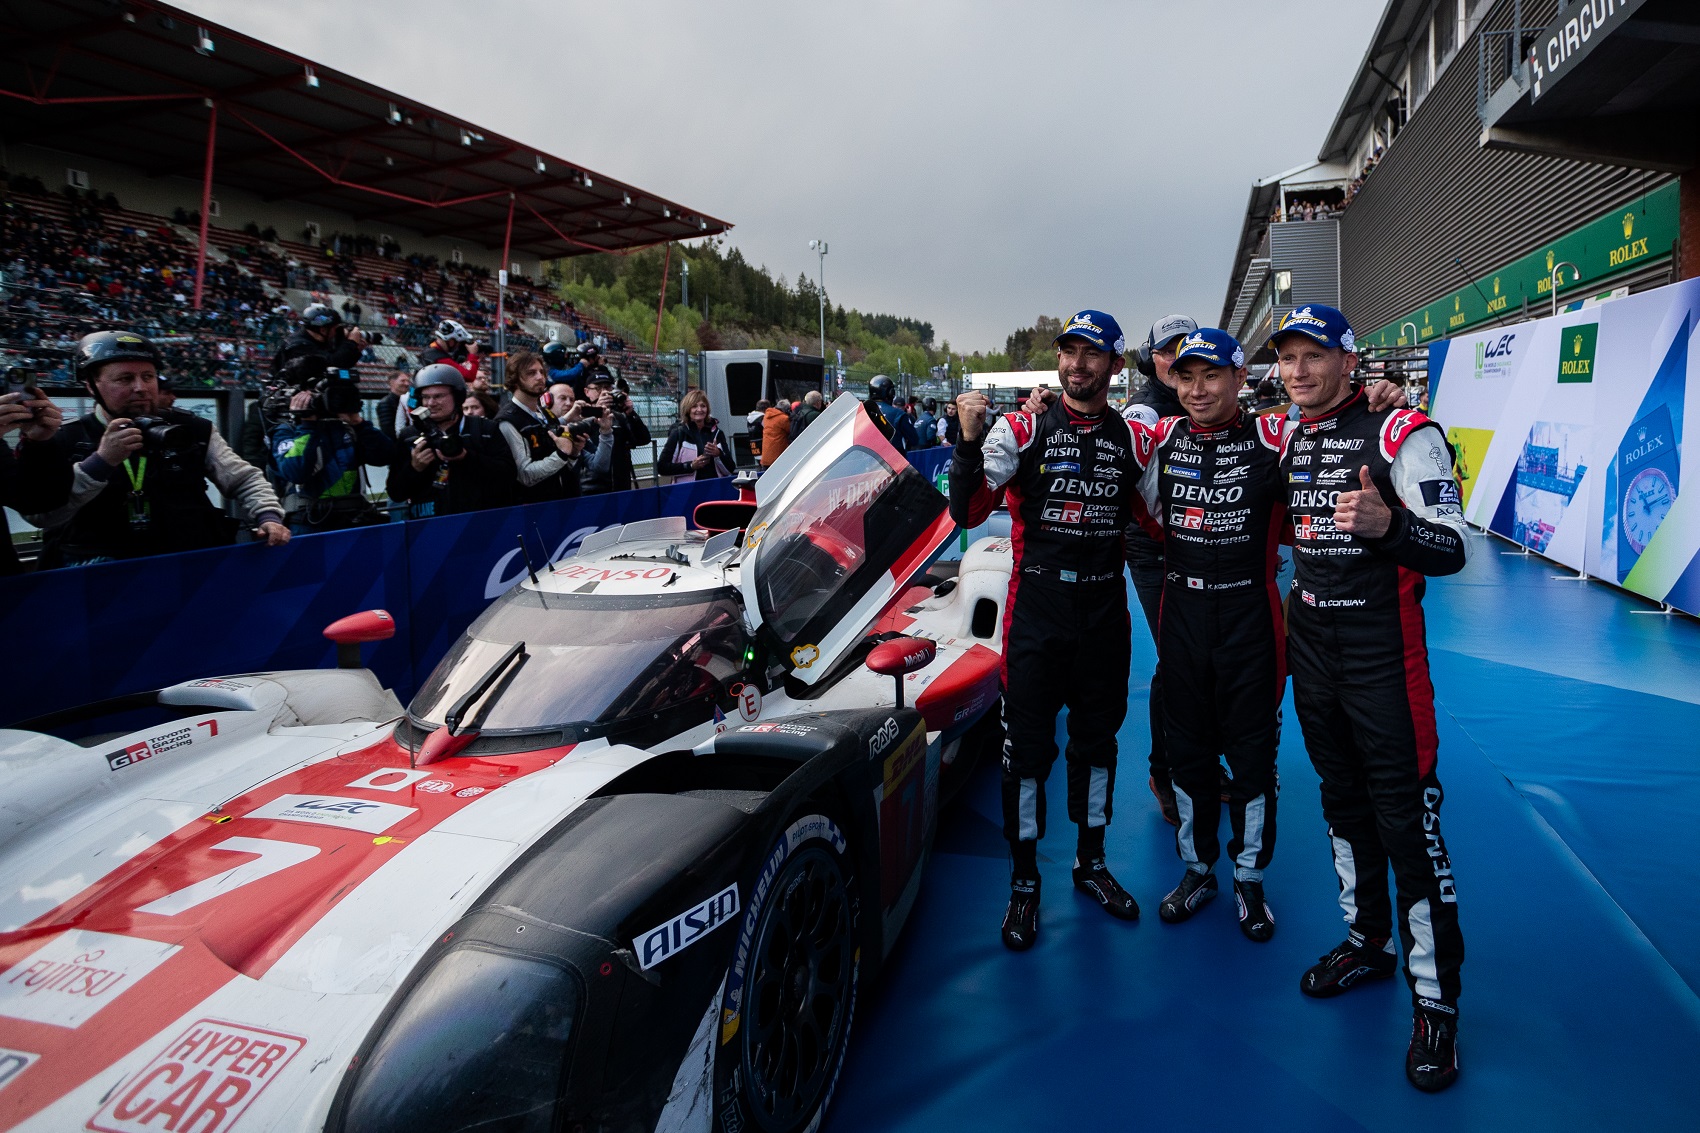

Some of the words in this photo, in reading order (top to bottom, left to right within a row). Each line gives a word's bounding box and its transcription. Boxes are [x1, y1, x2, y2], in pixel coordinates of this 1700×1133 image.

[1547, 0, 1626, 72] CIRCU
[1609, 238, 1648, 267] ROLEX
[1487, 296, 1507, 314] ROLEX
[1282, 318, 1327, 330] MICHELIN
[1450, 312, 1465, 327] ROLEX
[1475, 342, 1484, 369] 10
[1485, 334, 1515, 358] WEC
[1561, 360, 1590, 375] ROLEX
[1046, 430, 1079, 446] FUJITSU
[1175, 436, 1204, 452] FUJITSU
[1216, 443, 1243, 454] Mobil
[1322, 438, 1352, 450] Mobil
[1044, 447, 1080, 458] AISIN
[1096, 452, 1115, 462] ZENT
[1625, 435, 1664, 465] ROLEX
[1169, 452, 1202, 464] AISIN
[1216, 456, 1239, 466] ZENT
[1292, 455, 1312, 466] AISIN
[1321, 454, 1344, 464] ZENT
[1093, 465, 1122, 478] WEC
[1213, 465, 1251, 479] WEC
[1318, 468, 1352, 479] WEC
[1050, 478, 1119, 498] DENSO
[1171, 483, 1243, 504] DENSO
[1291, 489, 1341, 508] DENSO
[1043, 507, 1080, 522] GR
[1082, 517, 1114, 525] Racing
[1171, 513, 1202, 528] GR
[1203, 516, 1246, 525] GAZOO
[1206, 508, 1251, 518] TOYOTA
[1084, 529, 1121, 538] HYBRID
[1203, 524, 1243, 533] Racing
[1294, 524, 1311, 538] GR
[1171, 530, 1204, 543] RACING
[1203, 534, 1250, 546] HYBRID
[1310, 533, 1352, 543] Racing
[1312, 547, 1363, 556] HYBRID
[553, 565, 671, 581] DENSO
[904, 647, 926, 668] Mobil
[744, 693, 757, 716] E
[148, 727, 191, 744] TOYOTA
[197, 719, 218, 737] 7
[736, 724, 776, 733] GR
[773, 728, 807, 737] Racing
[152, 733, 191, 749] GAZOO
[869, 716, 899, 760] RAYS
[154, 738, 193, 755] Racing
[110, 747, 151, 769] GR
[416, 780, 452, 793] FIA
[294, 799, 381, 815] WEC
[792, 823, 808, 843] PILOT
[809, 821, 826, 832] SPORT
[1423, 786, 1457, 904] DENSO
[133, 836, 321, 916] 7
[735, 843, 785, 979] MICHELIN
[643, 889, 736, 967] AISIN
[9, 955, 127, 998] FUJITSU
[167, 1027, 288, 1079] HYPER
[113, 1061, 252, 1133] CAR
